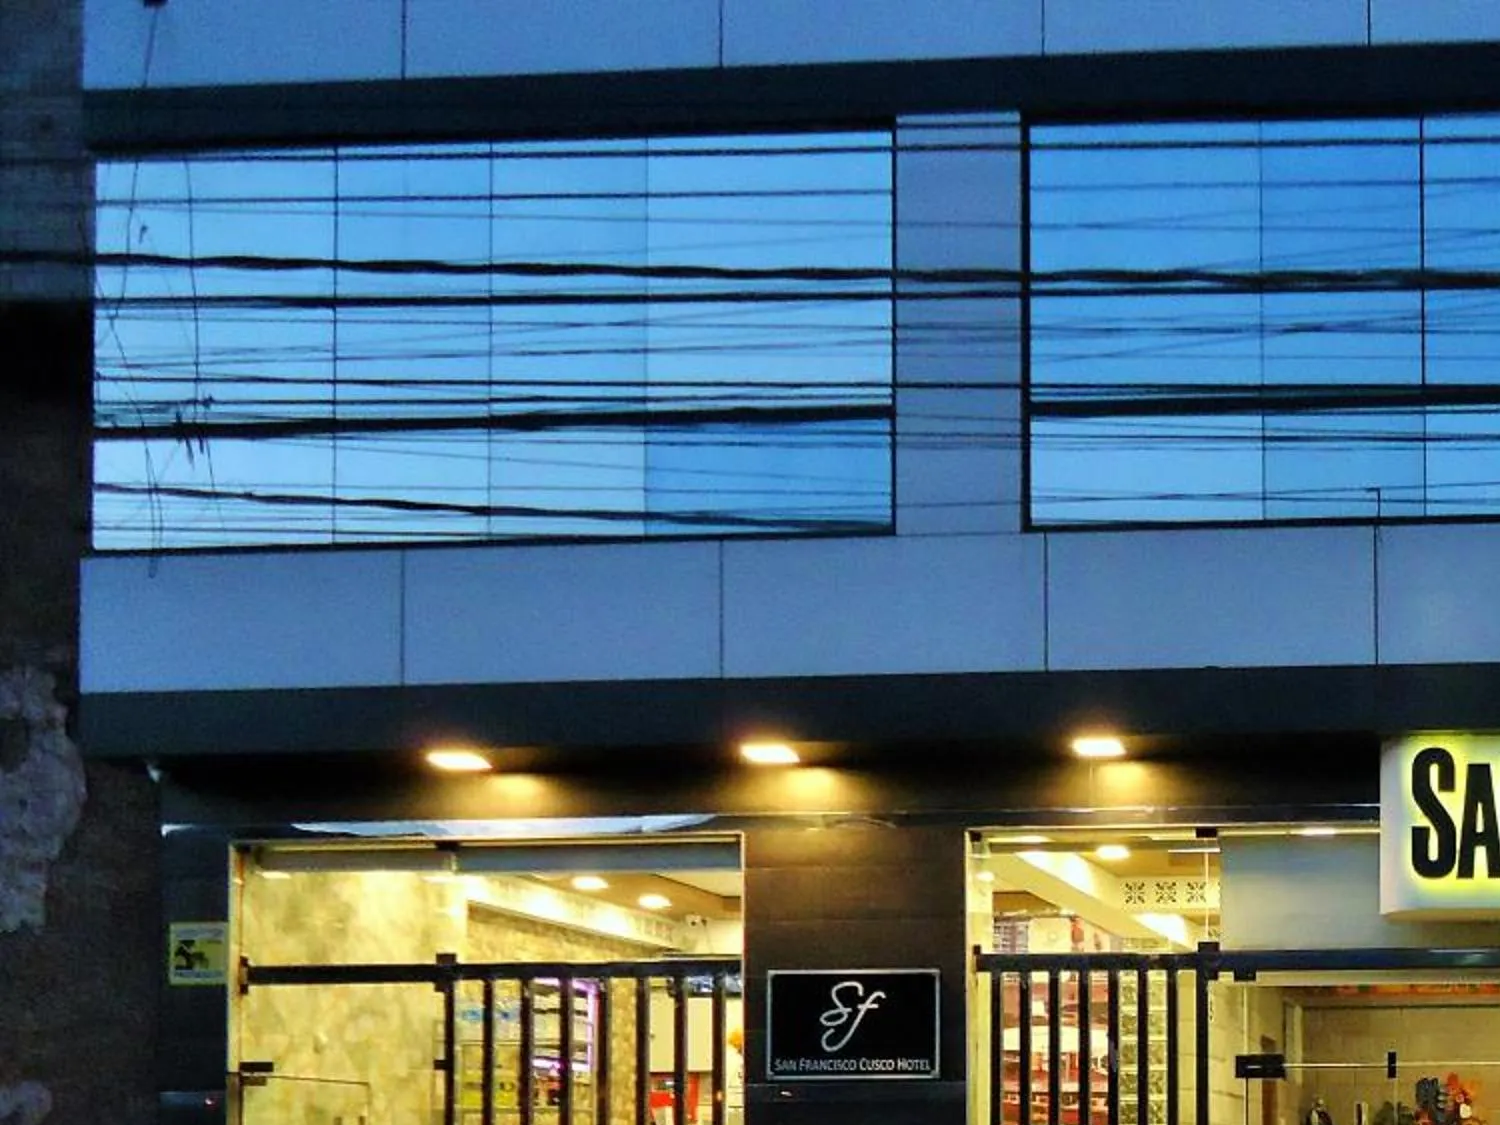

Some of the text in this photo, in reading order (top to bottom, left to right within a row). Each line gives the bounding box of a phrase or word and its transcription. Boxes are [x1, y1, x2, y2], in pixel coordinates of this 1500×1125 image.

[774, 1057, 931, 1072] SAN FRANCISCO CUSCO HOTEL
